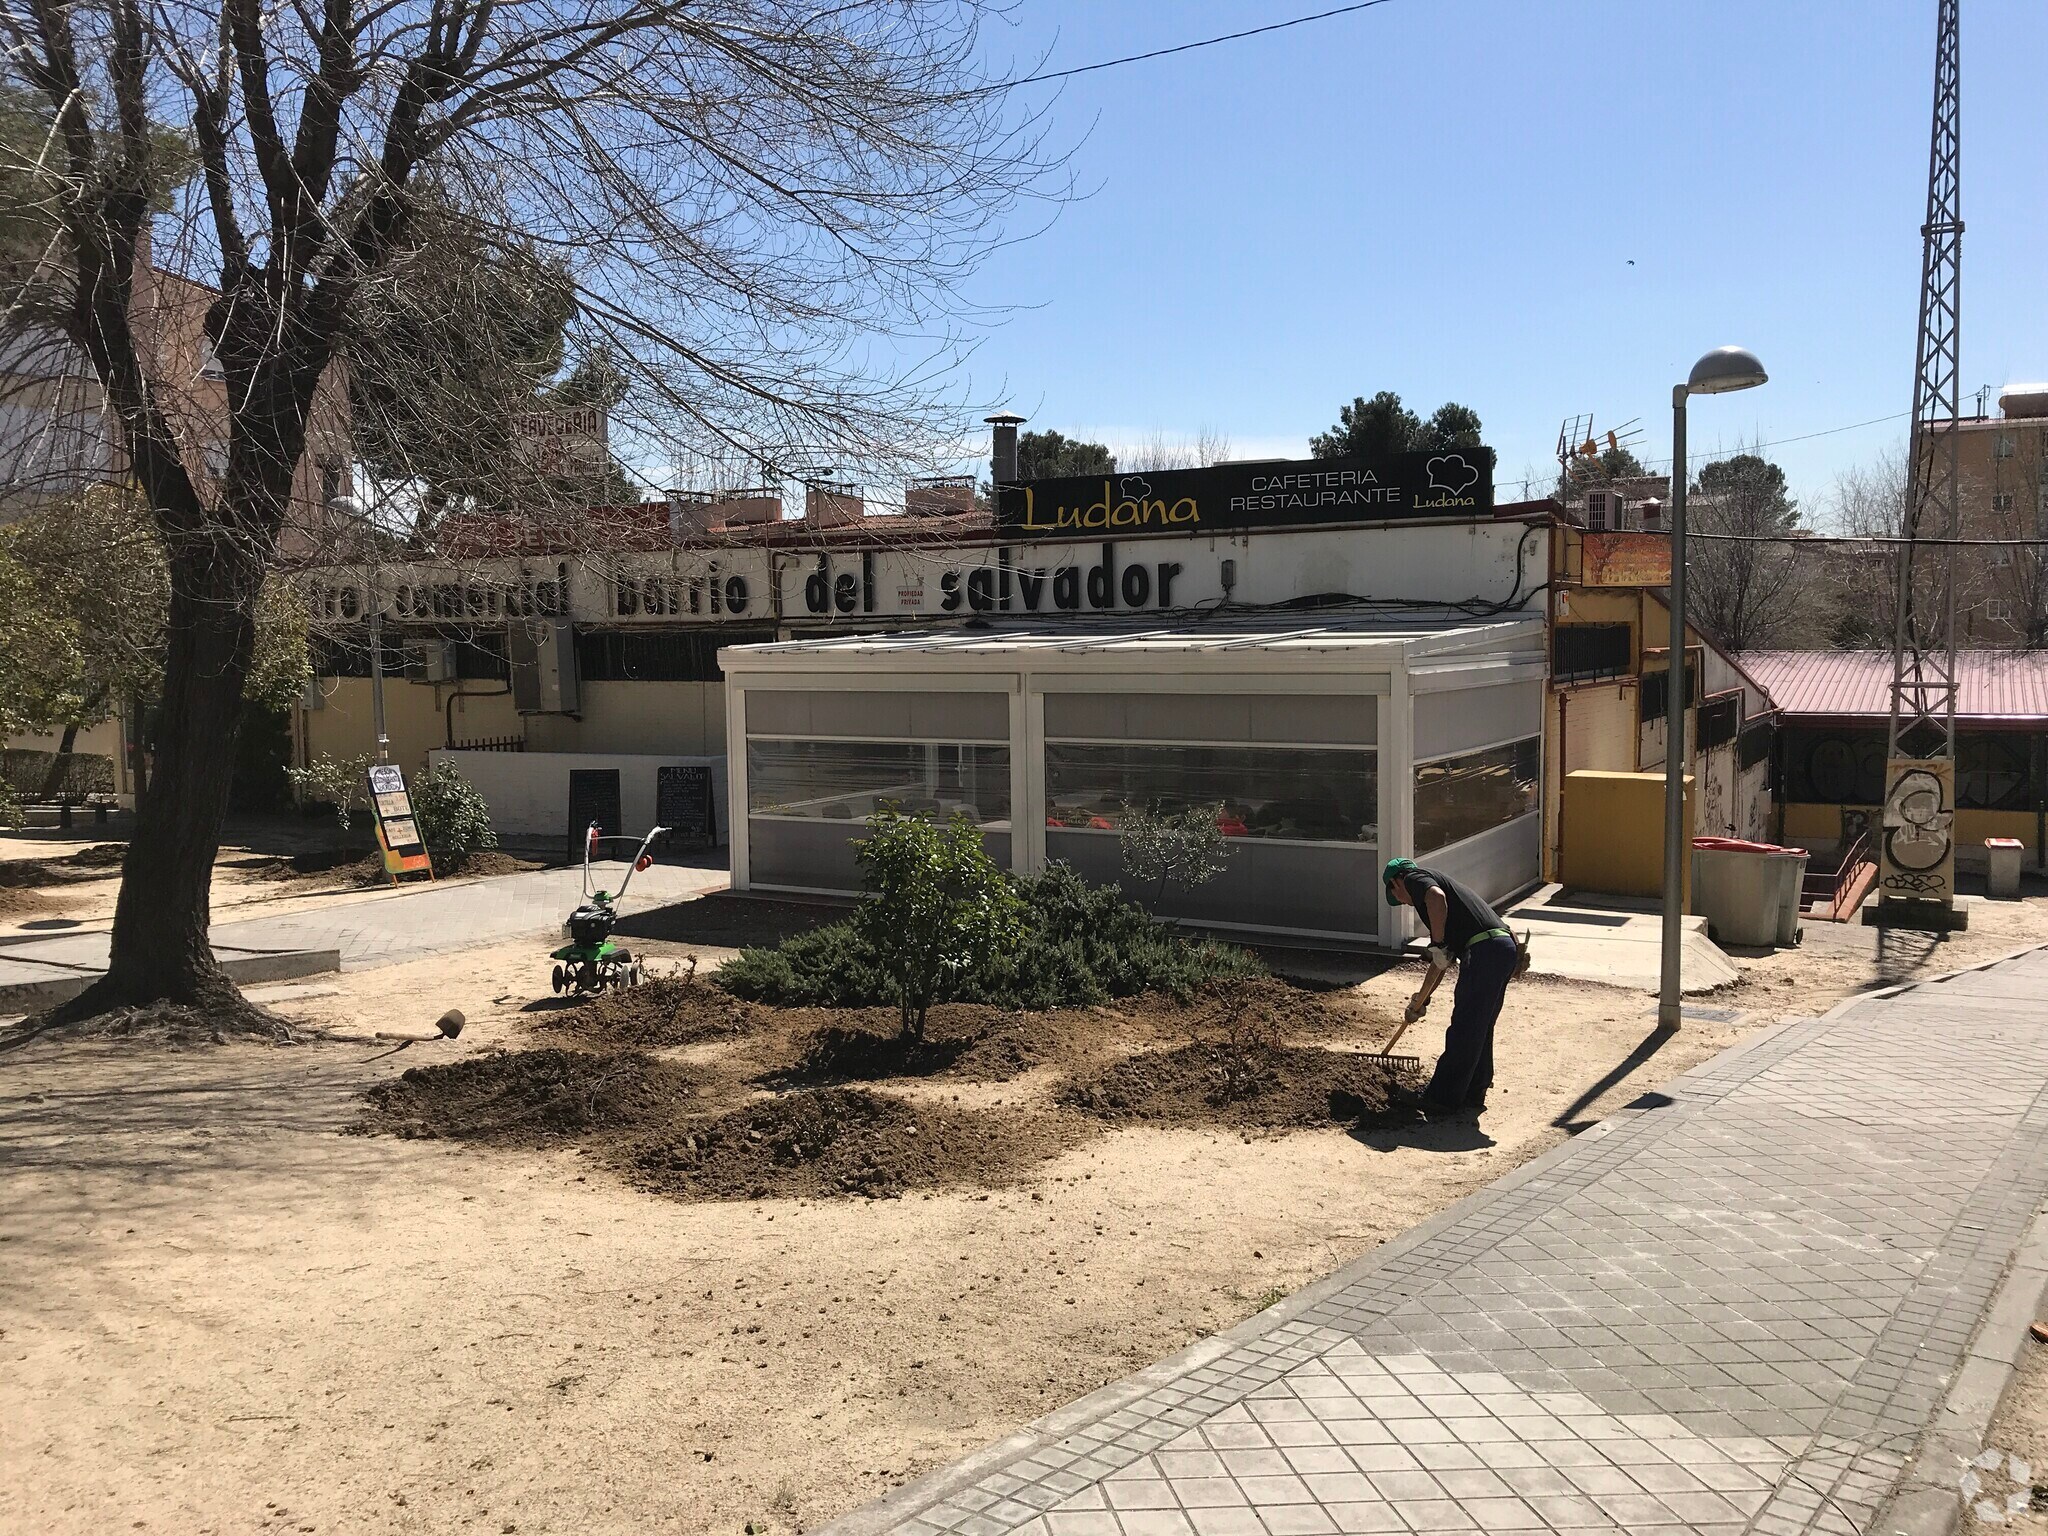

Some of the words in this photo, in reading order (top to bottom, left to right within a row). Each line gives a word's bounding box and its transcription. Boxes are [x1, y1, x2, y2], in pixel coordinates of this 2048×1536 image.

[1251, 469, 1378, 491] CAFETERIA
[1021, 480, 1200, 530] Ludana
[1230, 487, 1401, 511] RESTAURANTE
[1412, 494, 1475, 509] Ludana
[617, 560, 747, 615] barrio
[805, 551, 873, 613] del
[940, 542, 1181, 611] salvador
